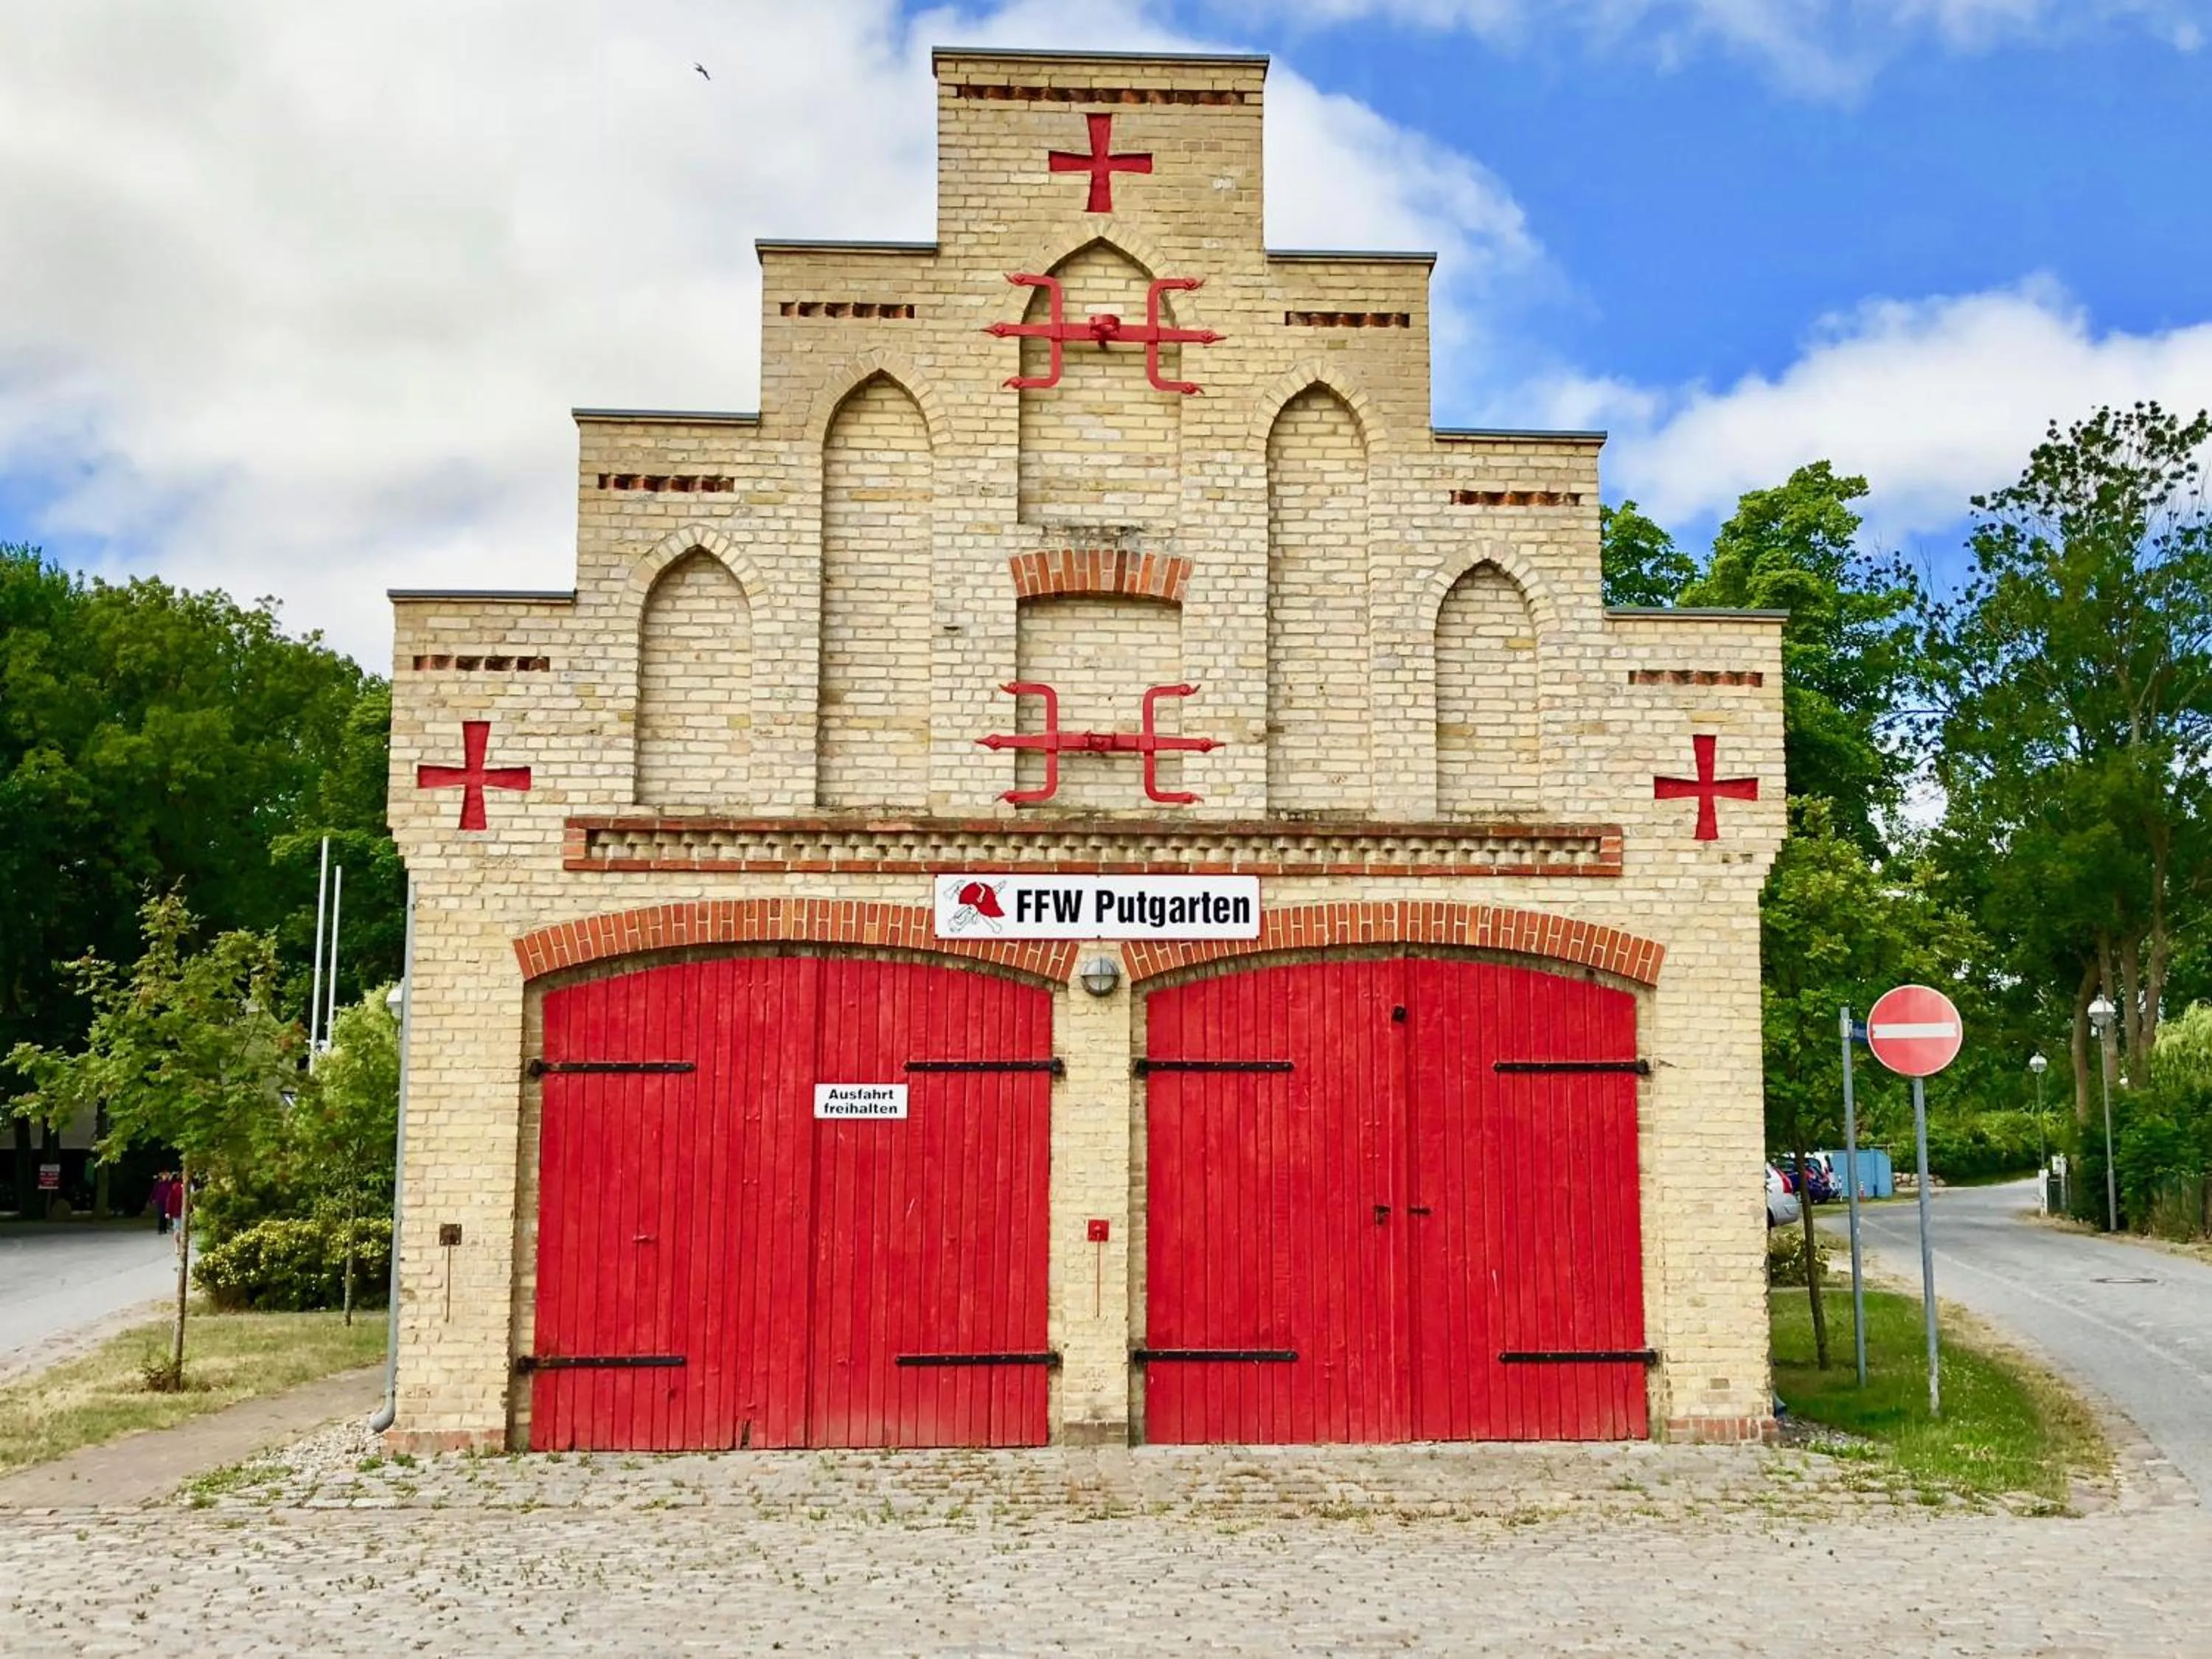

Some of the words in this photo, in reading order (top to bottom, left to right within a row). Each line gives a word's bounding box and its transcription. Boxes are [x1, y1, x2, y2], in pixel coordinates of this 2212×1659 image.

[1017, 890, 1083, 923] FFW
[1096, 890, 1250, 927] Putgarten
[829, 1089, 894, 1099] Ausfahrt
[824, 1103, 897, 1113] freihalten
